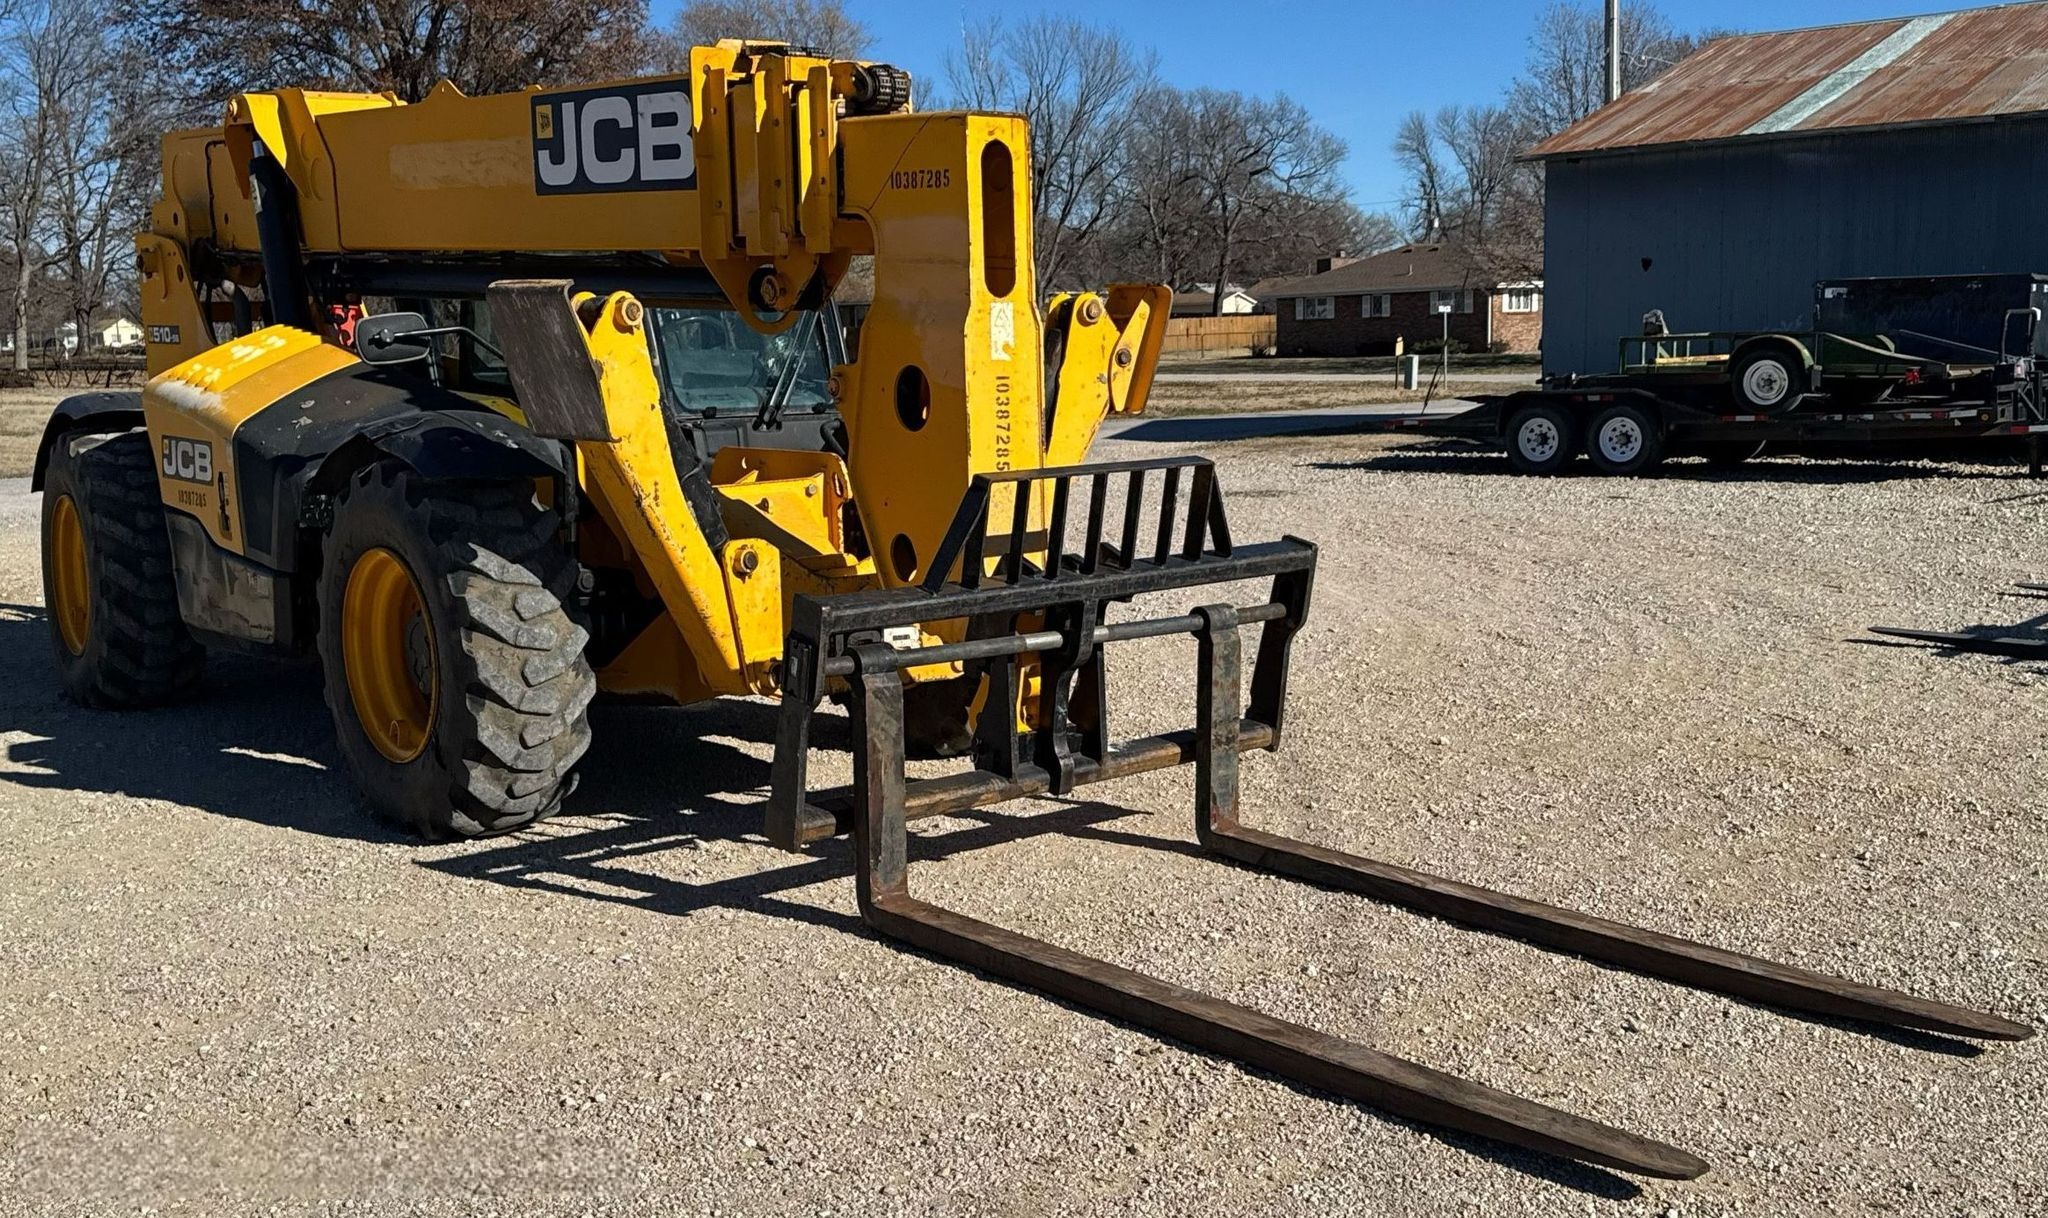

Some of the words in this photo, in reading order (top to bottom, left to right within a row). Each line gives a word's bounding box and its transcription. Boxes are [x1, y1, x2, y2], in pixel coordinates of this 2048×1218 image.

[538, 91, 695, 186] JCB
[891, 168, 950, 190] 10387285
[995, 376, 1011, 472] 10387285
[163, 439, 212, 482] JCB
